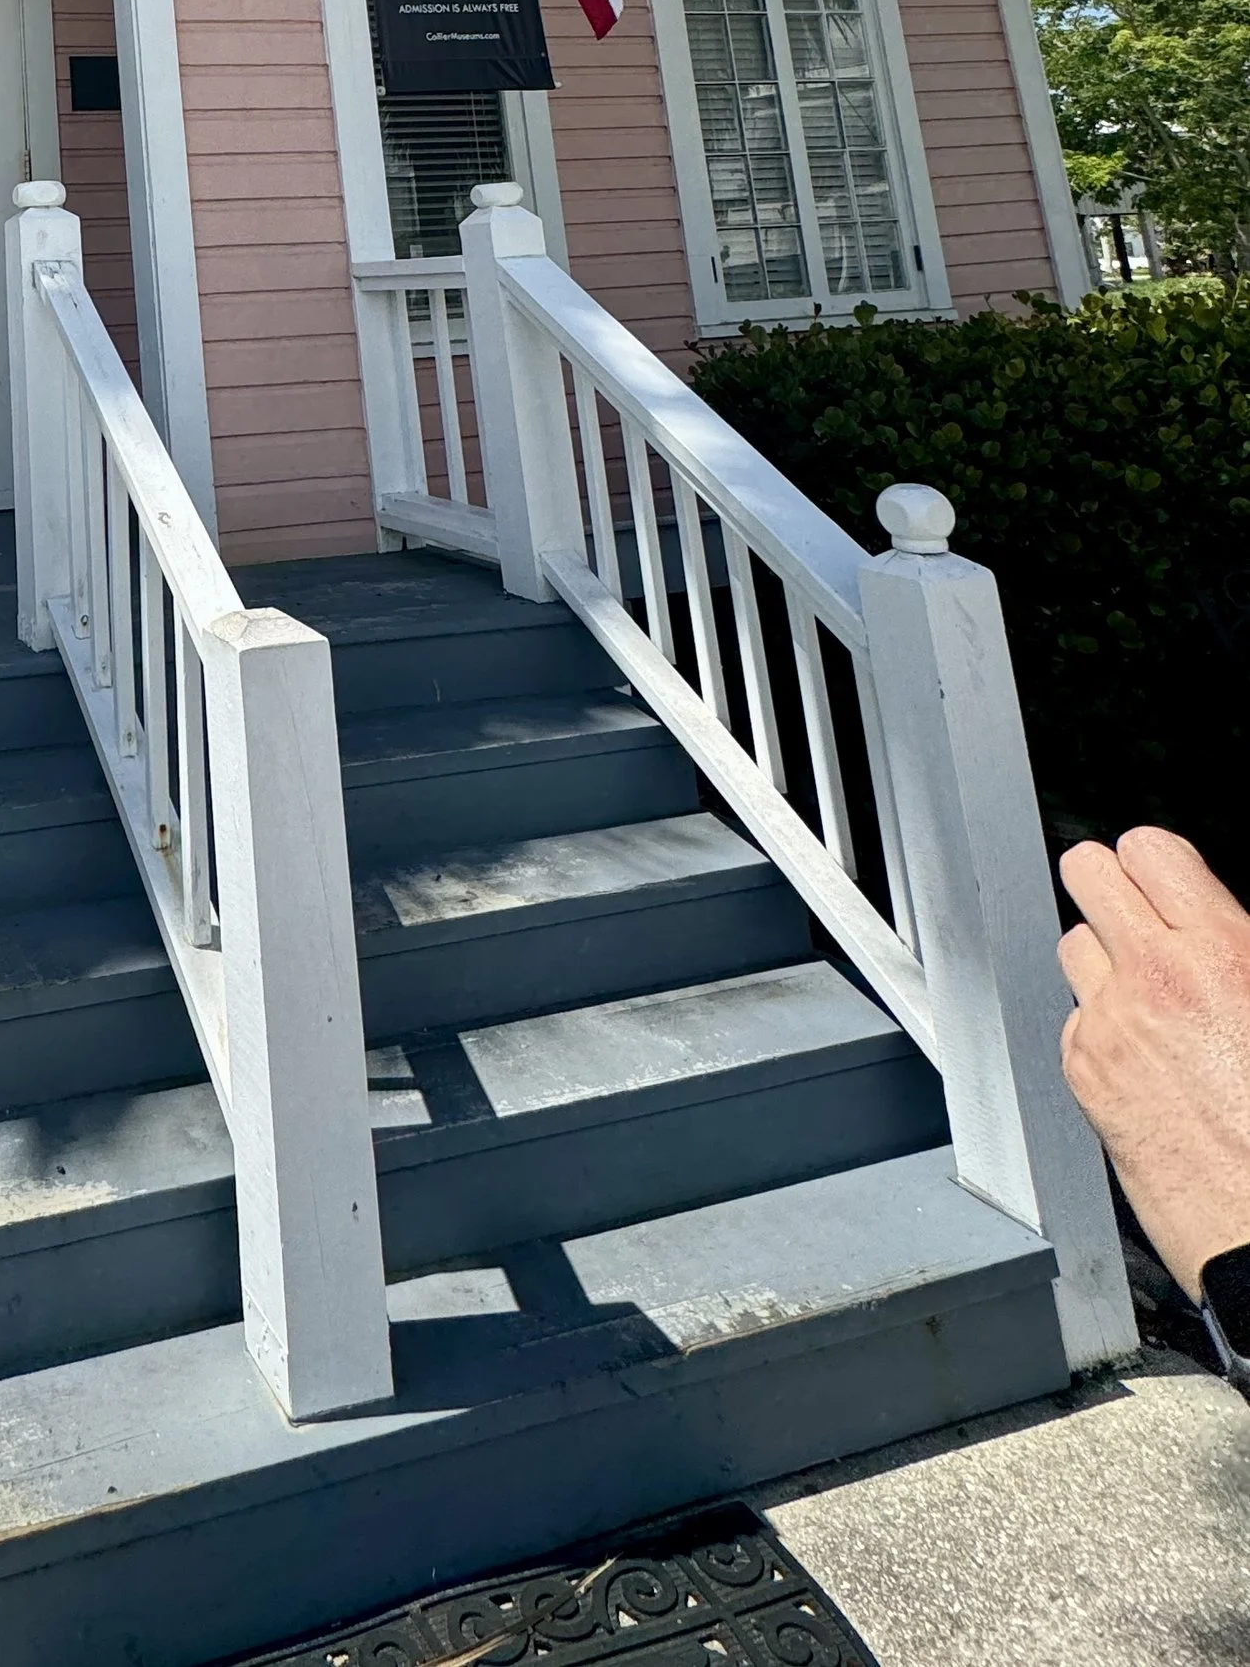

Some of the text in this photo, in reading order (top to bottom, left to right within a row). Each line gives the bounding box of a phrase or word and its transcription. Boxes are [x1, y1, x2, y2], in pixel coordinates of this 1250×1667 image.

[399, 3, 519, 13] ADMISSION IS ALWAYS FREE
